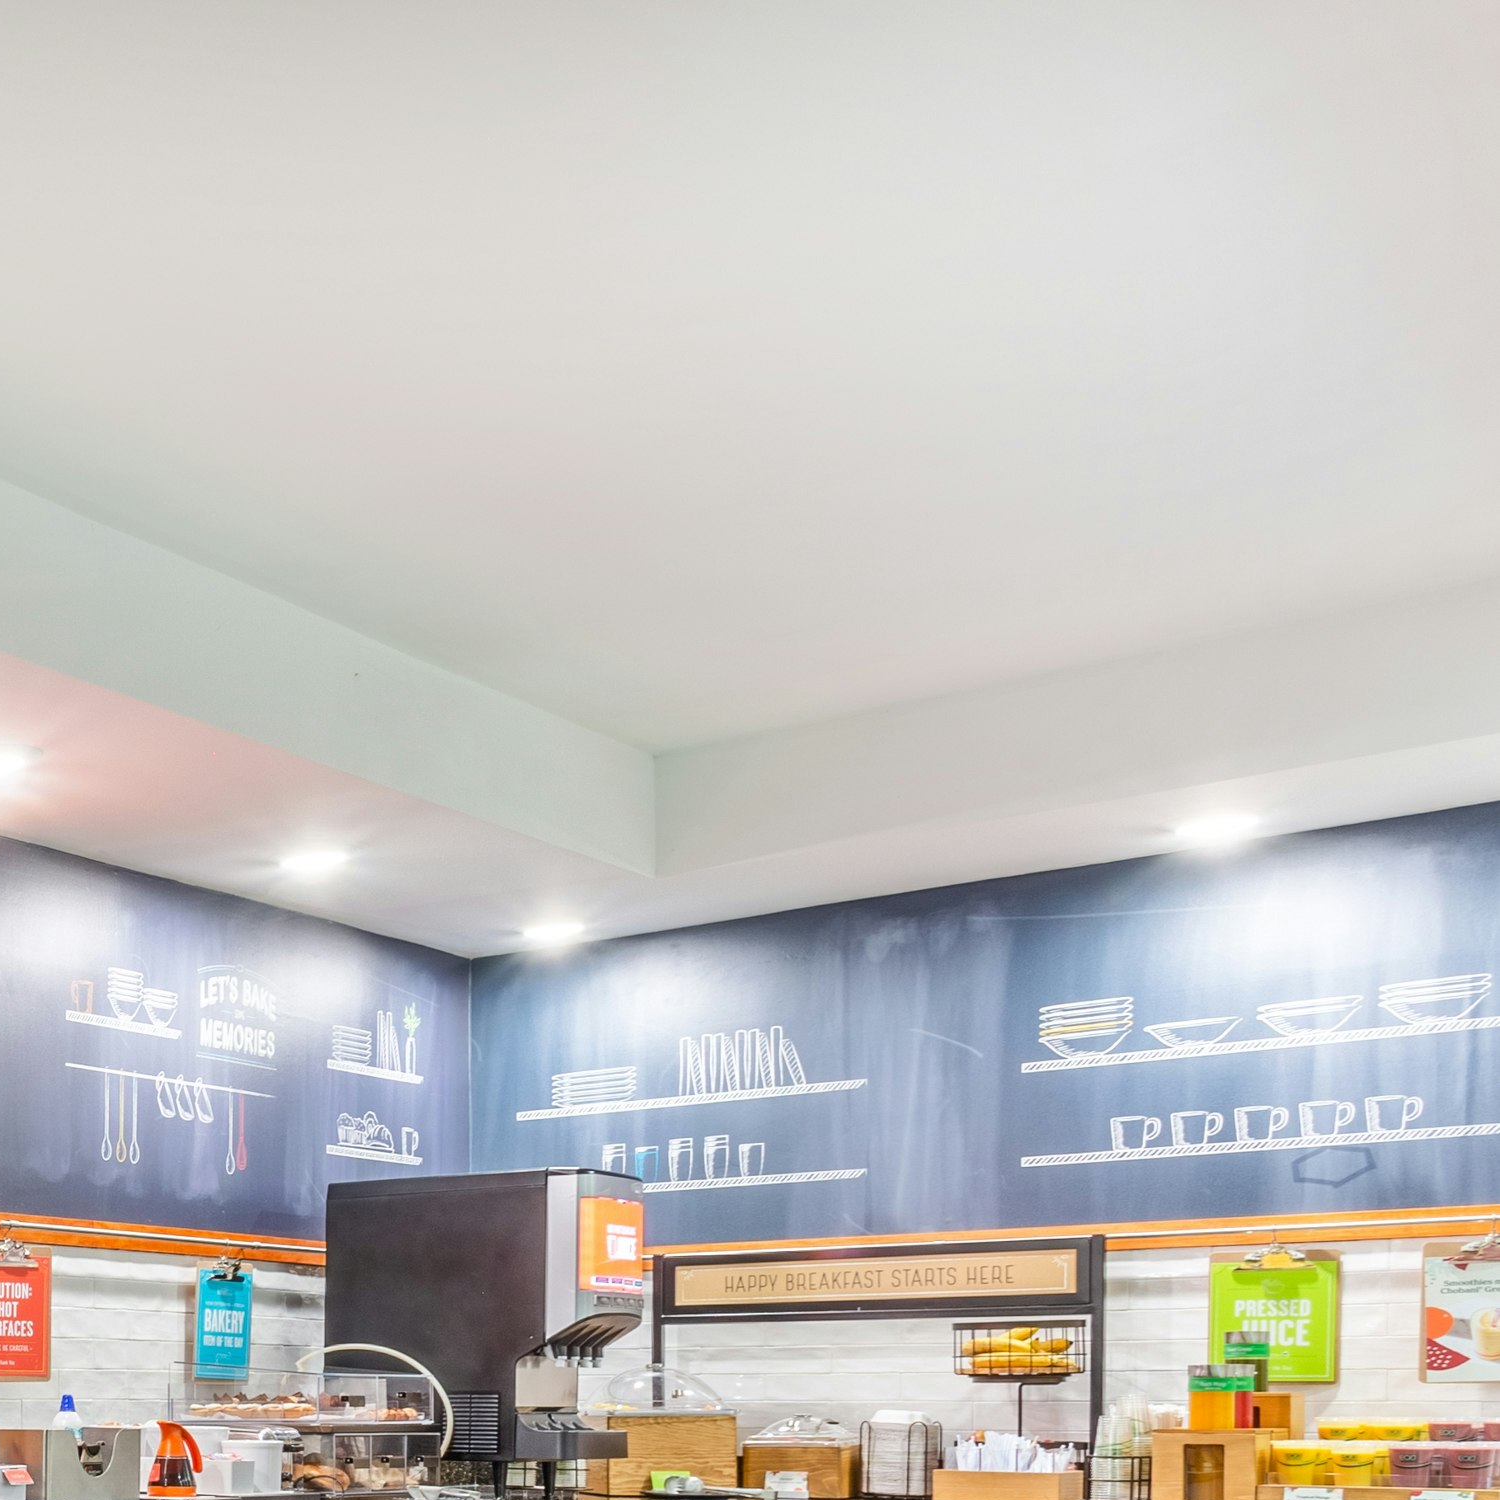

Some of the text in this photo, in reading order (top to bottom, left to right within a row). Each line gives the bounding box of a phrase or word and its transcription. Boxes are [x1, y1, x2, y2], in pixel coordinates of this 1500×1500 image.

[200, 975, 277, 1022] LET'S BAKE
[200, 1017, 275, 1059] MEMORIES
[724, 1264, 1015, 1293] HAPPY BREAKFAST STARTS HERE
[1443, 1279, 1492, 1287] Smoothies
[204, 1308, 245, 1334] BAKERY
[1234, 1299, 1312, 1317] PRESSED
[216, 1336, 223, 1347] OF
[224, 1336, 233, 1347] THE
